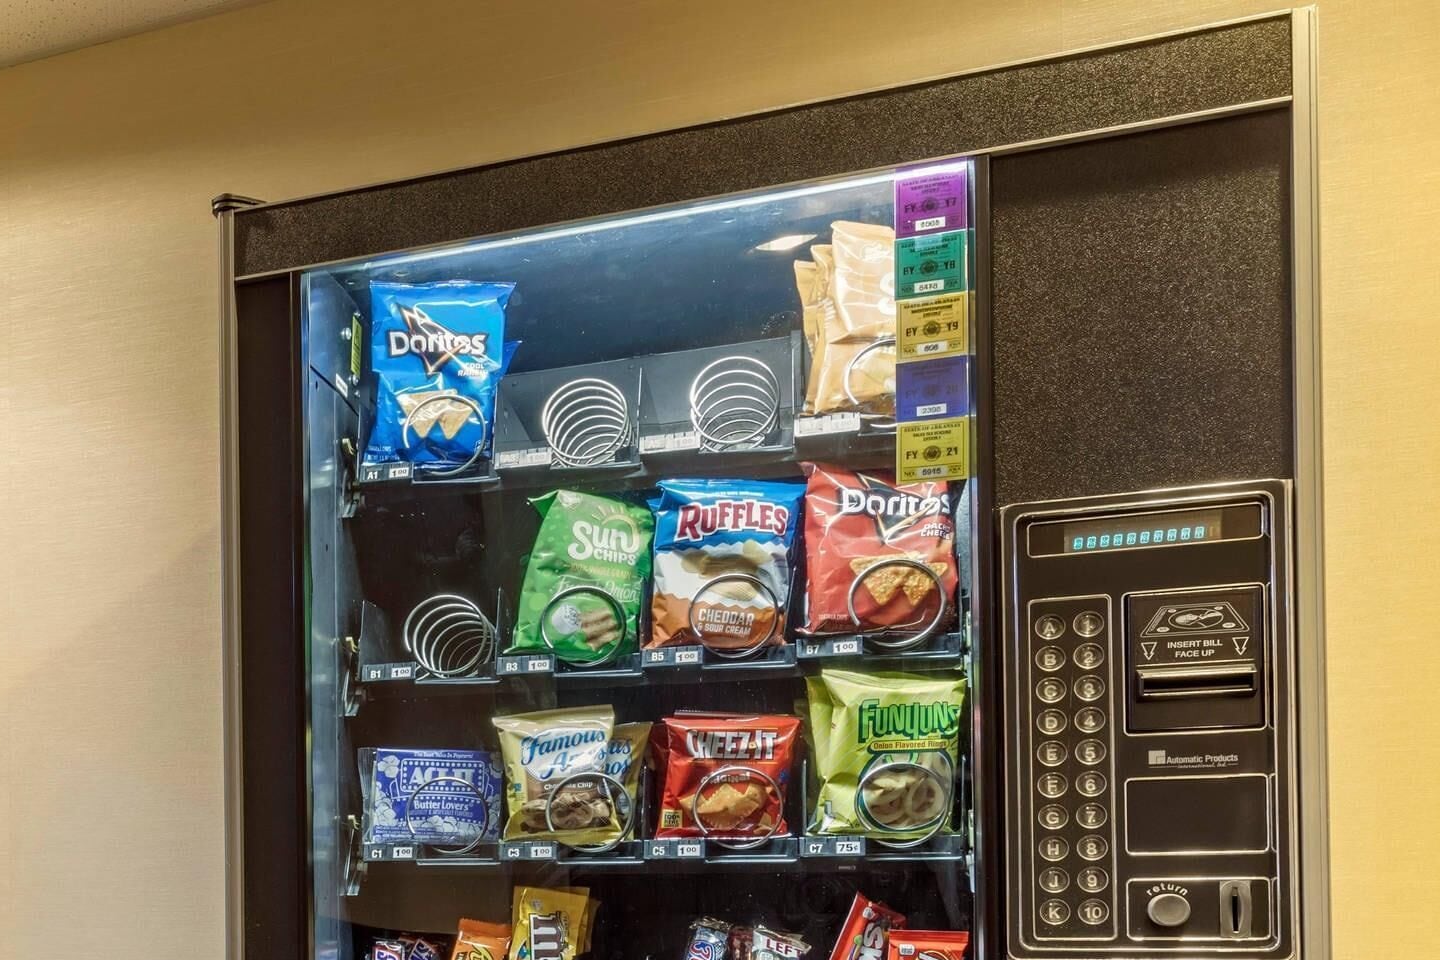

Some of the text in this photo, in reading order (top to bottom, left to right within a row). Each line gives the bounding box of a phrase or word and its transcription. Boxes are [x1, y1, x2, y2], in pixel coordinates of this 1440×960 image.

[388, 330, 487, 357] Doritos
[946, 447, 958, 456] 21
[367, 470, 378, 479] A1
[842, 488, 950, 516] Doritos
[675, 499, 789, 542] RUFFLES
[568, 521, 631, 560] Sun
[594, 550, 637, 566] CHIPS
[698, 608, 755, 626] CHEDDAR
[704, 623, 724, 633] SOUR
[725, 625, 751, 636] CREAM
[1043, 622, 1056, 635] A
[1082, 619, 1091, 631] 1
[806, 645, 819, 654] B7
[1167, 639, 1223, 648] INSERT BILL
[652, 652, 664, 661] B5
[1044, 654, 1057, 666] B
[1083, 651, 1094, 663] 2
[1175, 650, 1200, 658] FACE
[506, 662, 518, 671] B3
[370, 669, 381, 678] B1
[1044, 685, 1057, 697] C
[1084, 683, 1095, 695] 3
[1045, 717, 1058, 729] D
[1084, 715, 1095, 727] 4
[521, 730, 605, 765] Famous
[873, 742, 893, 750] Onion
[895, 740, 925, 749] Flavored
[1047, 748, 1058, 760] E
[1084, 747, 1095, 759] 5
[1166, 753, 1239, 764] Automatic Products
[409, 767, 475, 786] ACT II
[1047, 780, 1058, 793] F
[1085, 779, 1096, 791] 6
[414, 800, 469, 811] Butter Lovers
[1046, 811, 1059, 824] G
[1086, 811, 1096, 823] 7
[371, 849, 382, 858] C1
[508, 848, 520, 857] C3
[653, 847, 665, 856] C5
[810, 843, 823, 853] C7
[1047, 844, 1059, 855] H
[1086, 843, 1097, 855] 8
[1048, 875, 1058, 887] J
[1087, 875, 1097, 887] 9
[1146, 882, 1189, 896] return
[1048, 907, 1060, 918] K
[1084, 907, 1102, 918] 10
[766, 938, 801, 959] LEFT
